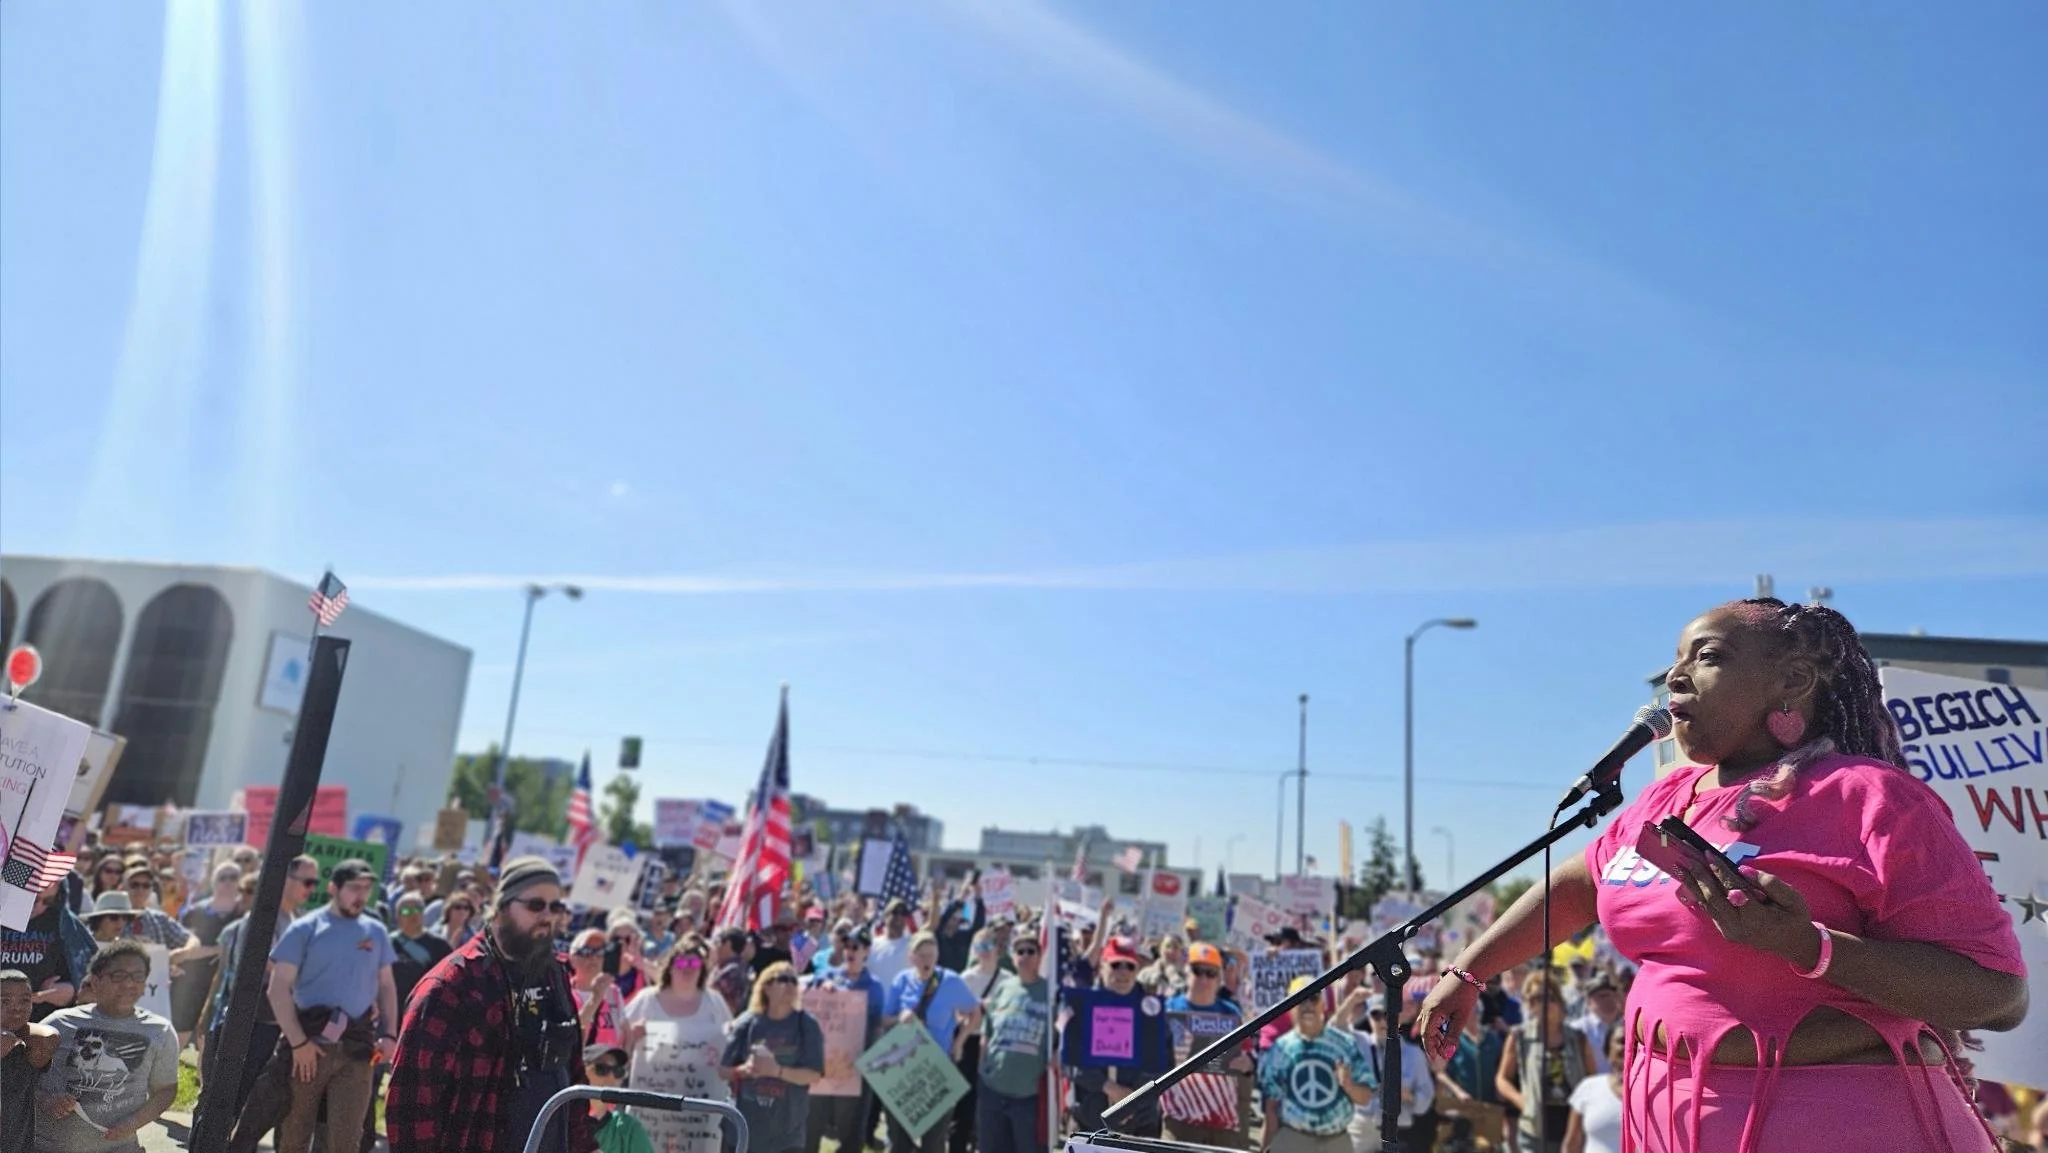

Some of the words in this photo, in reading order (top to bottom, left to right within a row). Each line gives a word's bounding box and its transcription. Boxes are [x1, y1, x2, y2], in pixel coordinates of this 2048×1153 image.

[1886, 686, 2042, 742] BEGICH
[1900, 730, 2048, 783] SULLIV
[0, 777, 28, 795] ING
[0, 951, 44, 964] RUMP
[1191, 1016, 1235, 1035] Resist
